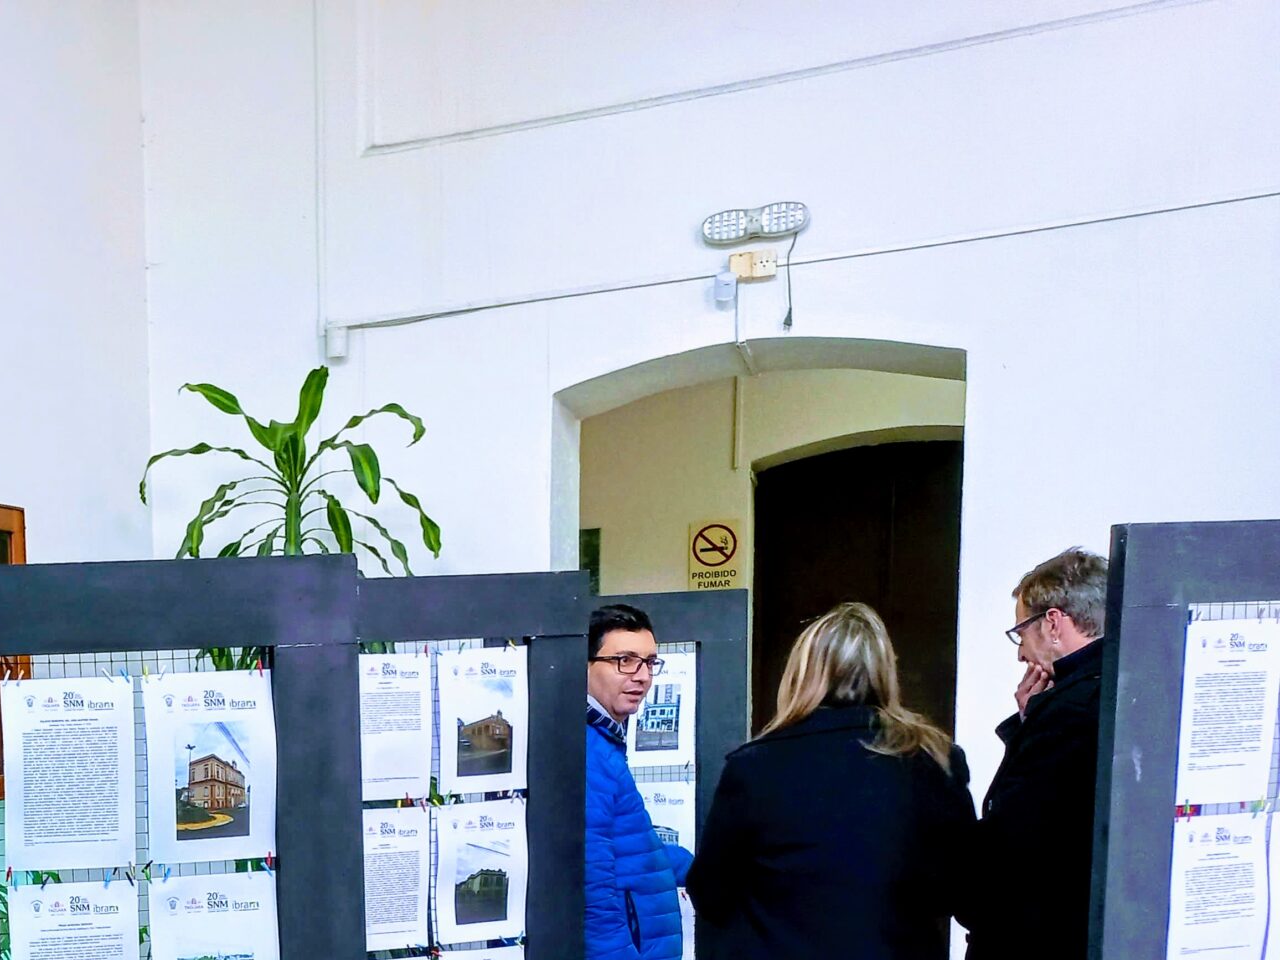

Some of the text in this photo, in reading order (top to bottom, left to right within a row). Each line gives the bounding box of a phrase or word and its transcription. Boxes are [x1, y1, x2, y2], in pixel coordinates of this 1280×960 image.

[692, 569, 737, 579] PROIBIDO
[697, 579, 731, 589] FUMAR
[64, 700, 84, 708] SNM
[204, 699, 225, 707] SNM
[70, 904, 90, 912] SNM
[232, 901, 259, 909] ibram
